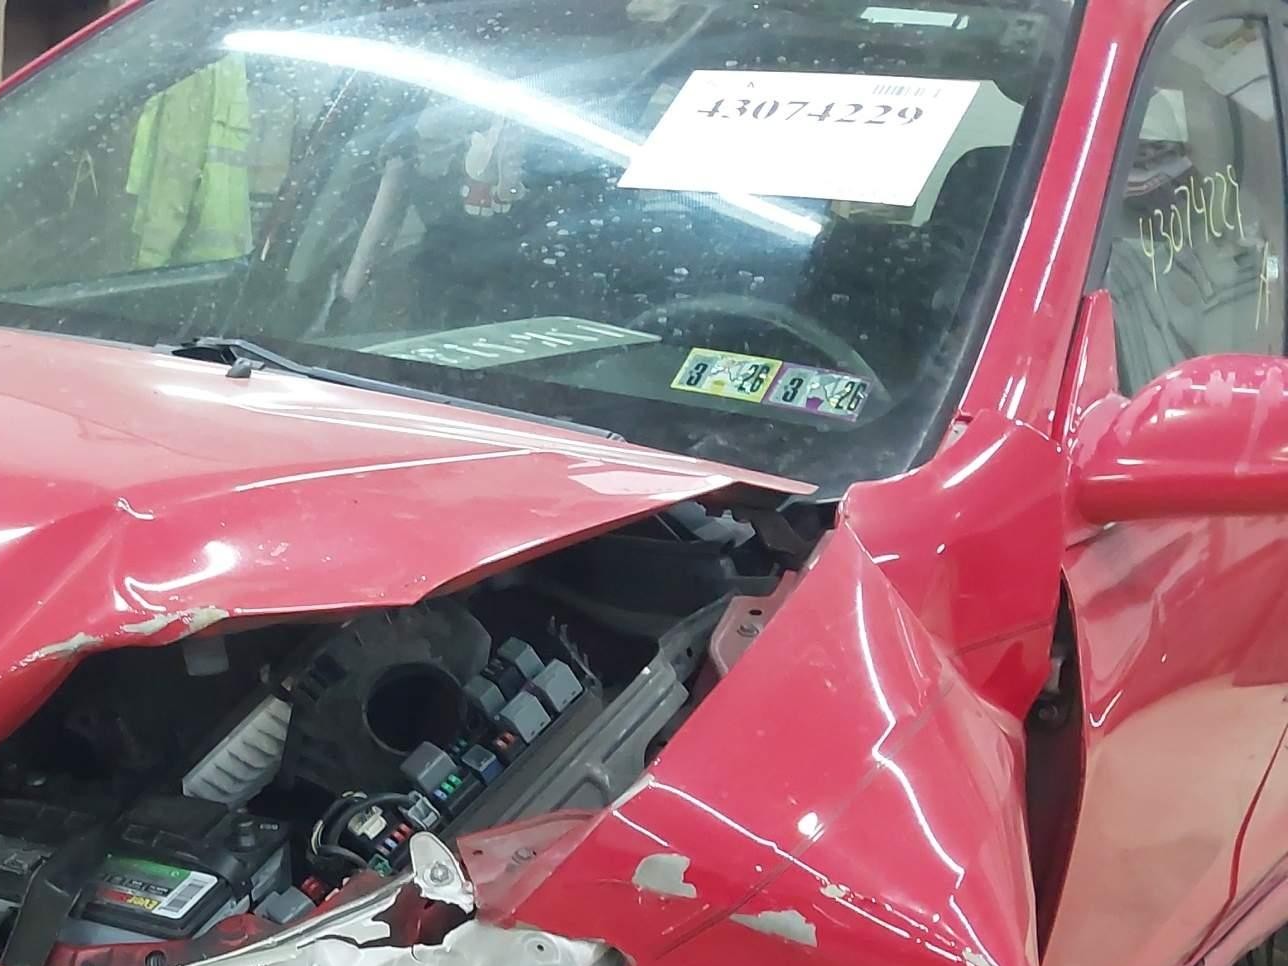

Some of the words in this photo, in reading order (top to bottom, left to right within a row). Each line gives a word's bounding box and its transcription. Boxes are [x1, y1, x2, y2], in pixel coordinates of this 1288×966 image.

[697, 99, 924, 126] 43074229
[1139, 164, 1246, 294] 43074229
[738, 363, 771, 394] 26
[782, 377, 804, 402] 3
[834, 381, 867, 412] 26
